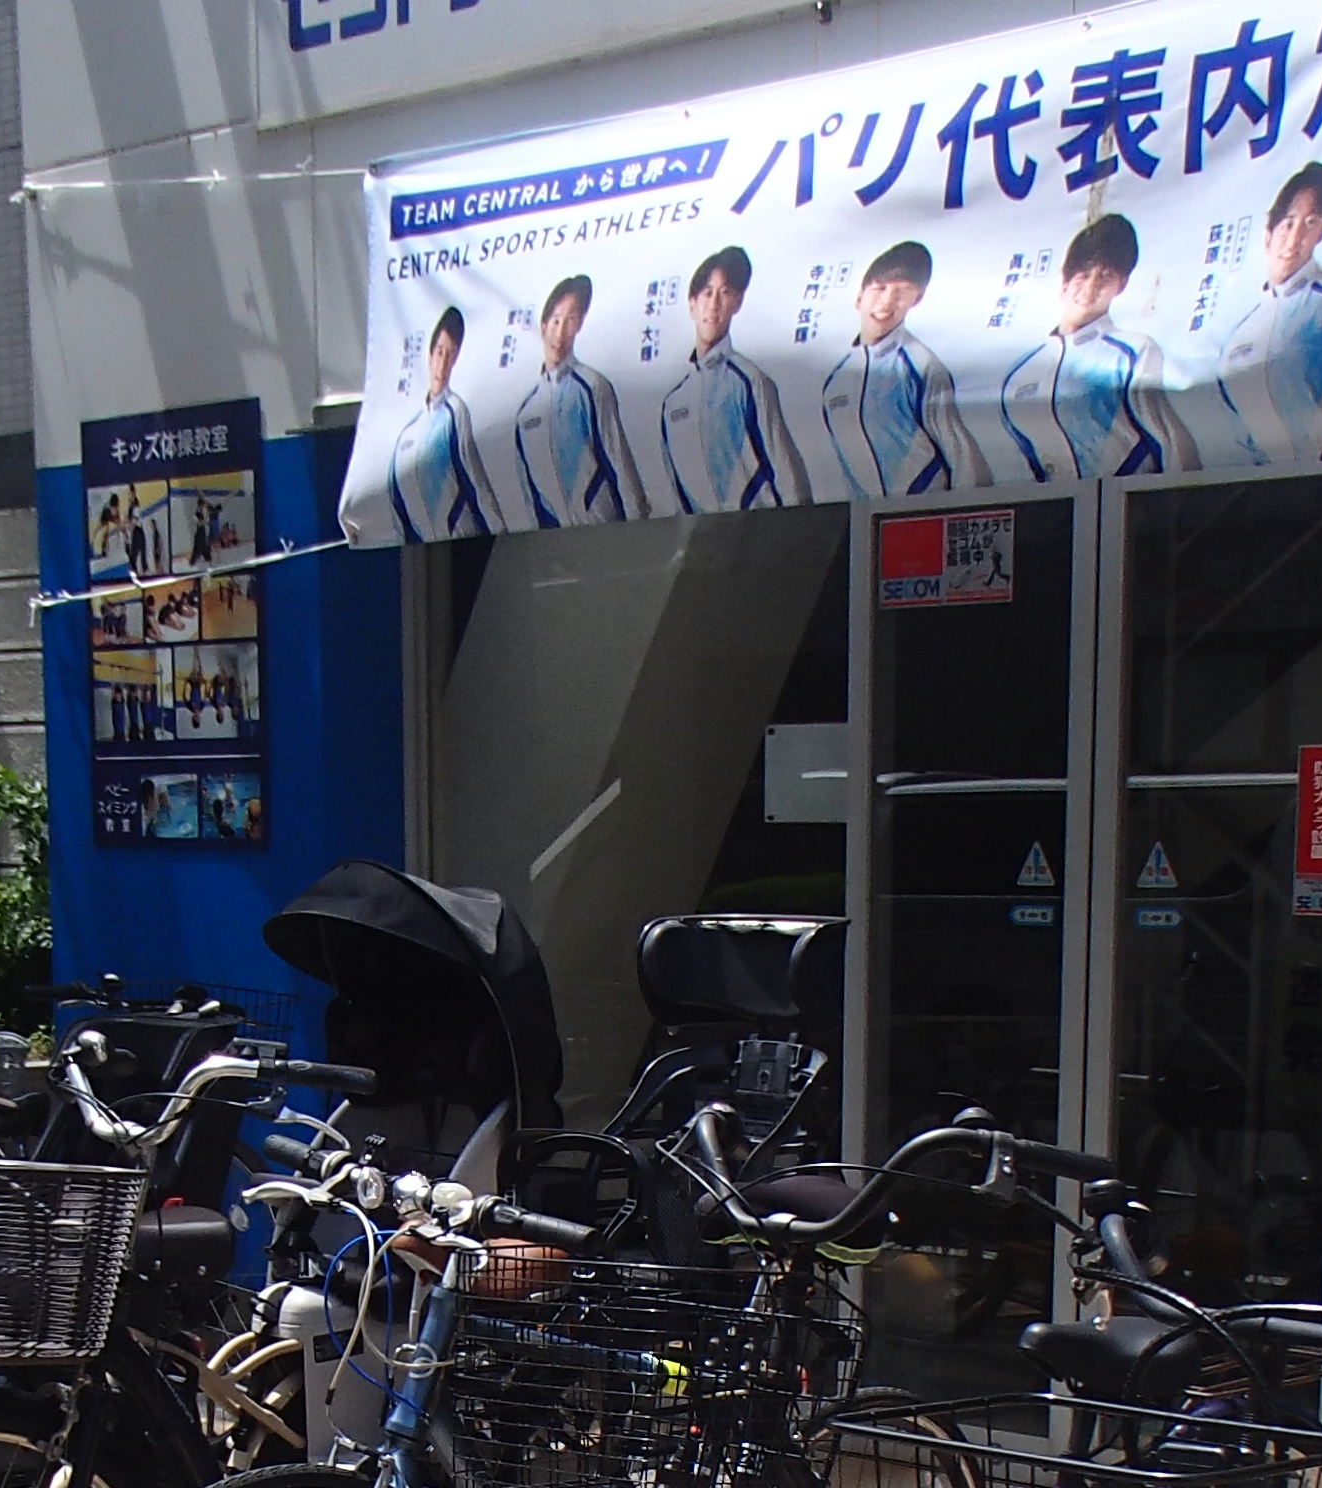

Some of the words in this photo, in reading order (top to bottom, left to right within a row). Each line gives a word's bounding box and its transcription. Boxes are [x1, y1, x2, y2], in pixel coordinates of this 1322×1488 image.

[401, 200, 456, 226] TEAM
[463, 181, 562, 217] CENTRAL
[386, 243, 471, 282] CENTRAL
[478, 225, 568, 262] SPORTS
[573, 198, 703, 243] ATHLETES
[110, 424, 230, 466] キッズ体操教室
[98, 801, 138, 815] スイミング
